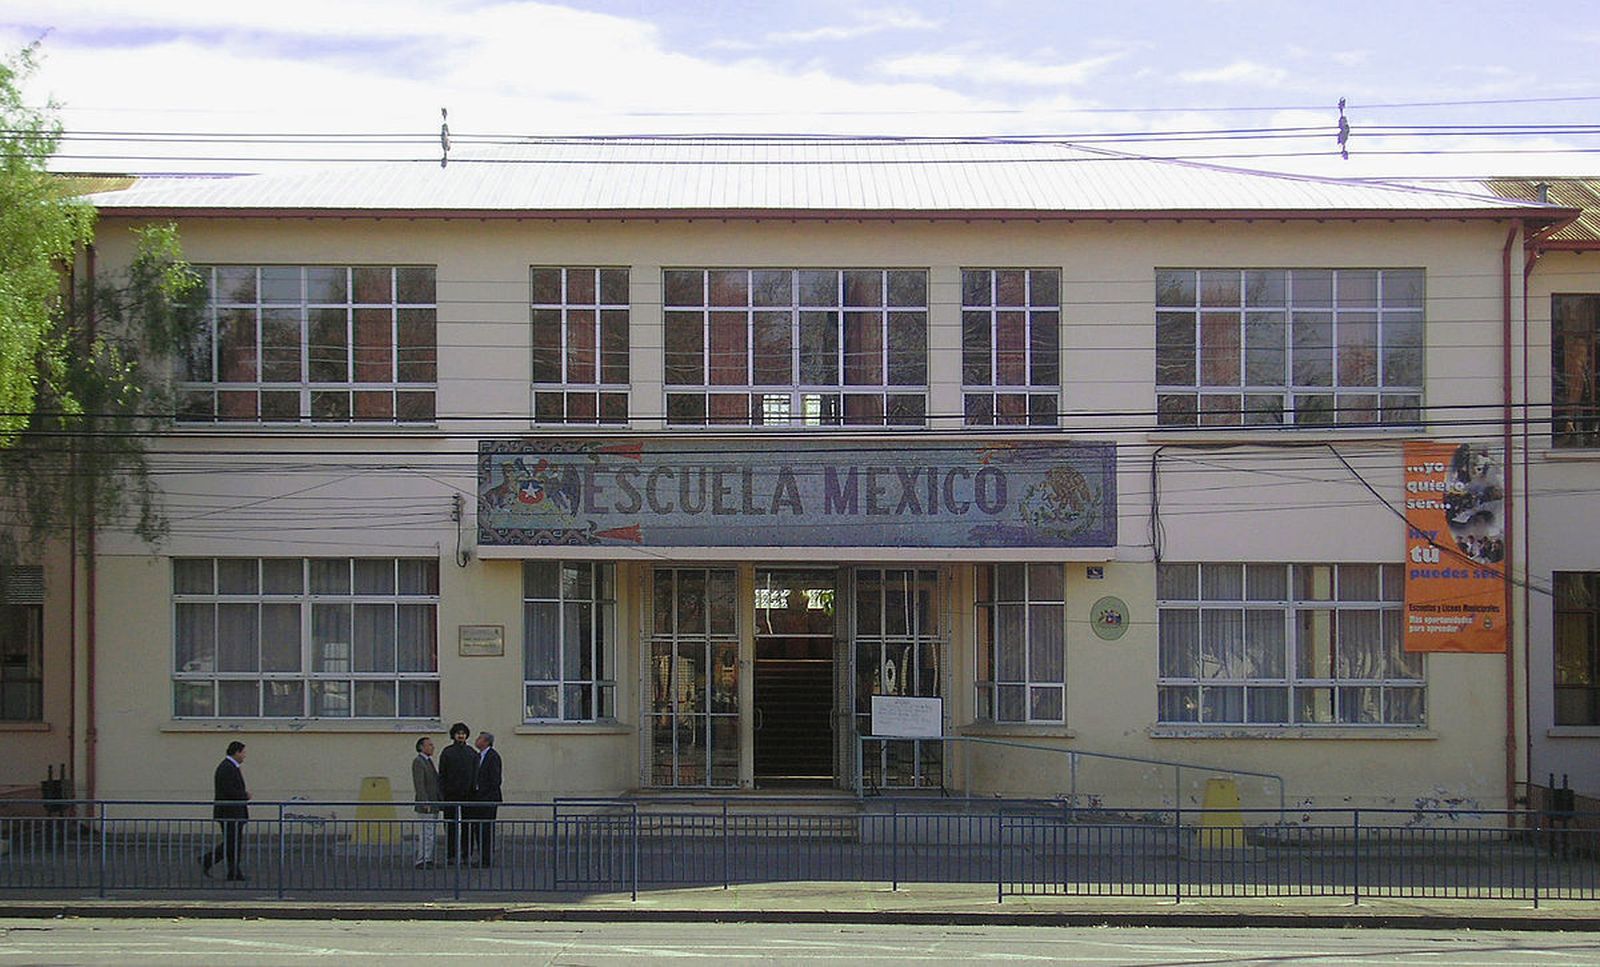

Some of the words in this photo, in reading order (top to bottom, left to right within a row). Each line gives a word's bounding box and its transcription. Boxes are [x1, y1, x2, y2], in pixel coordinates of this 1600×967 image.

[583, 465, 803, 515] ESCUELA
[824, 466, 1008, 515] MEXICO
[1407, 480, 1466, 493] quiero
[1407, 498, 1451, 509] ser...
[1410, 545, 1440, 563] tú
[1410, 567, 1469, 580] puedes
